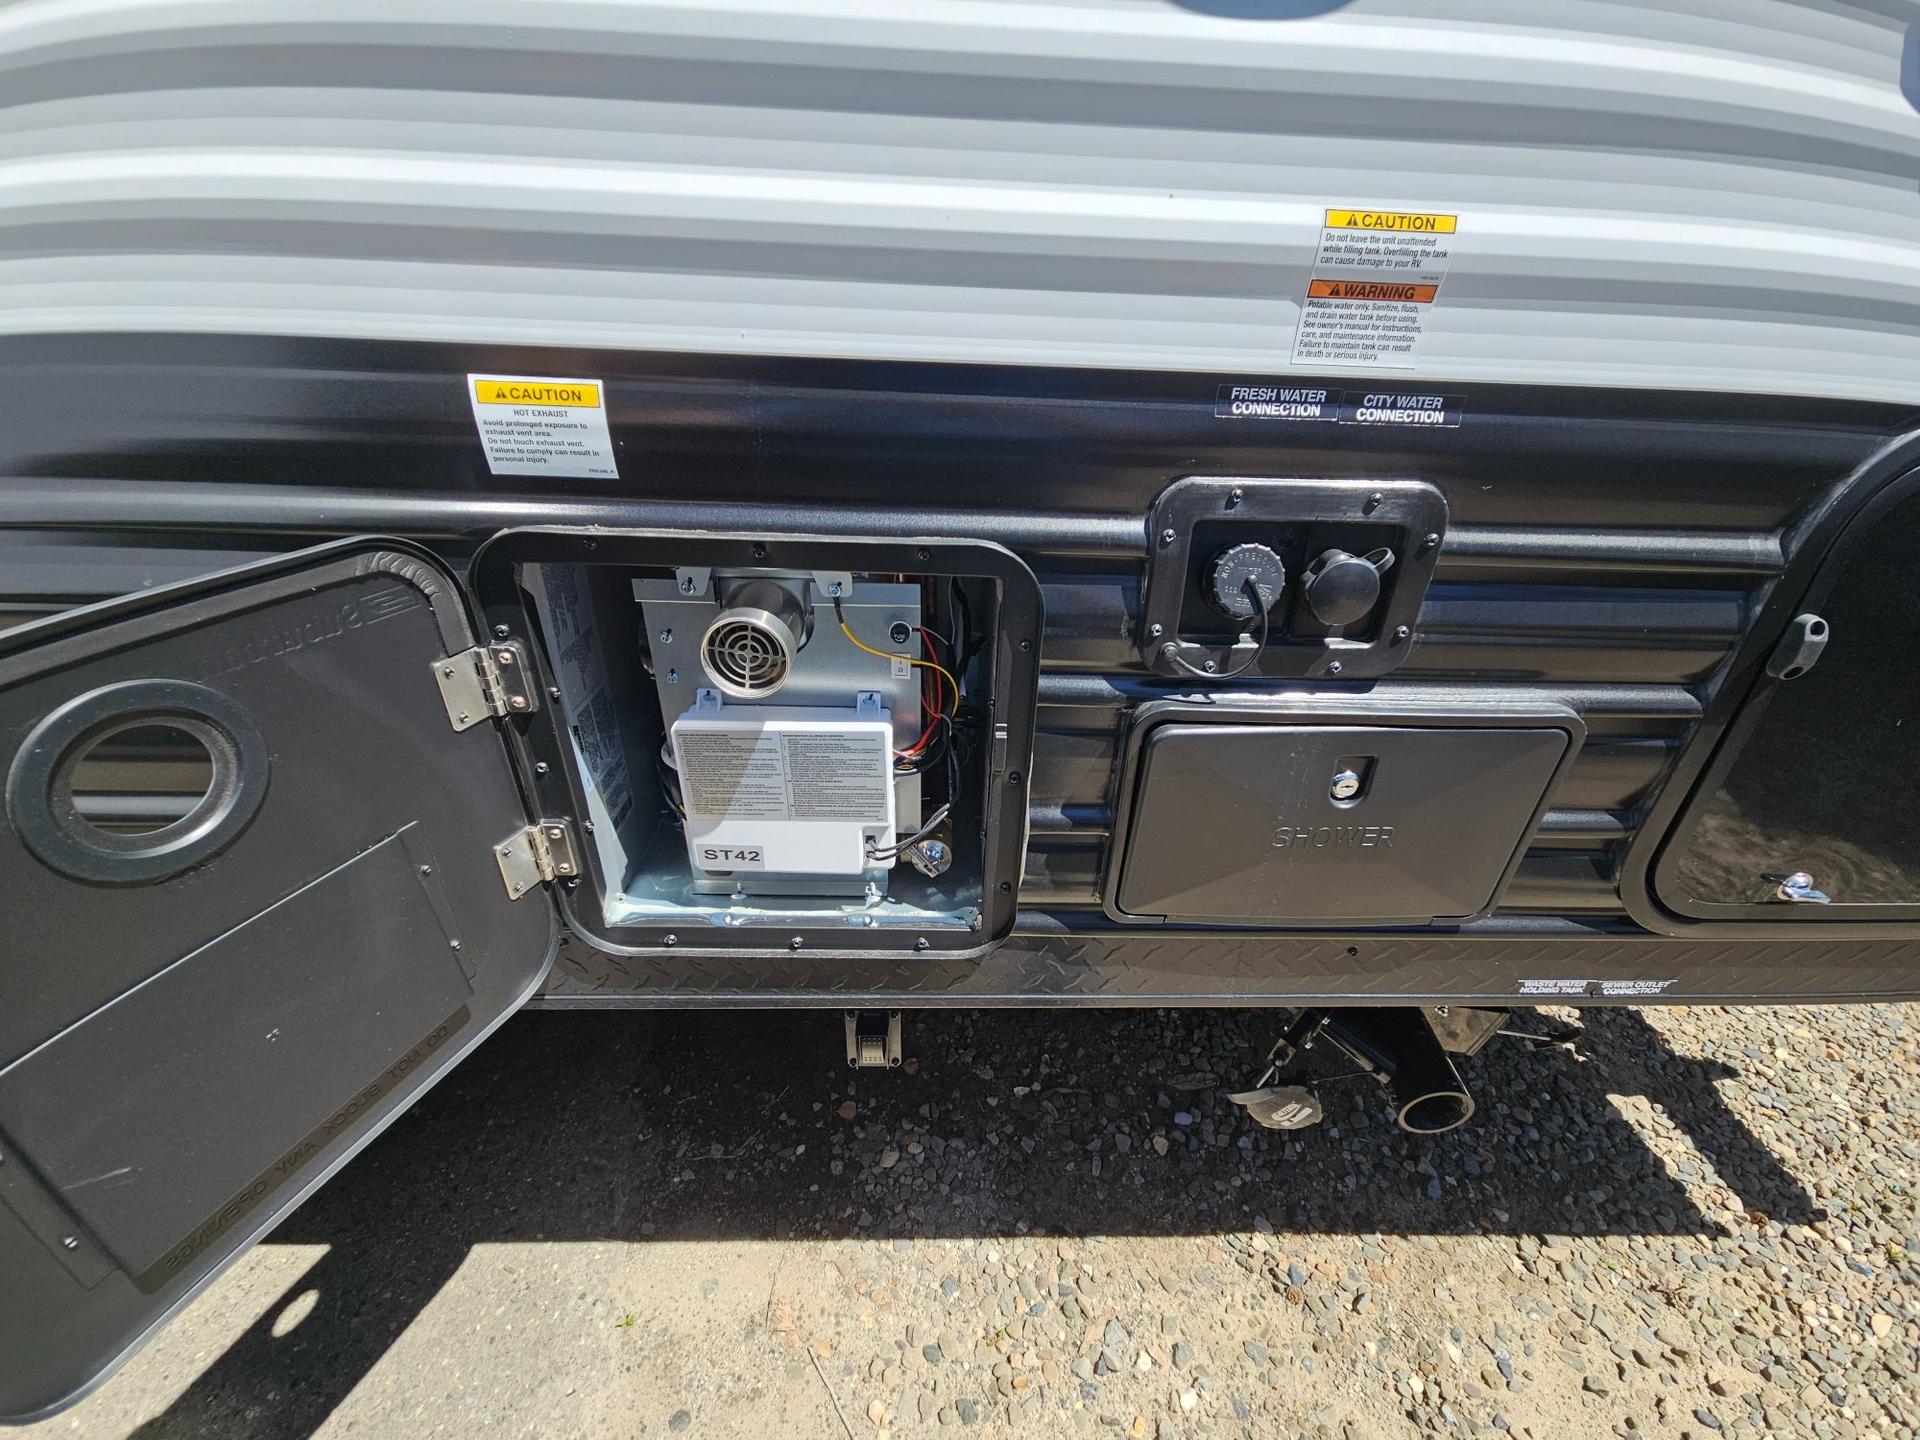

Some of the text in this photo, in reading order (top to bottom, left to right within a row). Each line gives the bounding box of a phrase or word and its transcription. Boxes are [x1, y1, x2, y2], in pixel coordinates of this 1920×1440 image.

[1362, 214, 1436, 230] CAUTION
[1326, 233, 1335, 241] Do
[1337, 234, 1348, 242] not
[1350, 234, 1368, 243] leave
[1382, 236, 1396, 244] unit
[1397, 237, 1436, 246] unattended
[1323, 245, 1342, 253] while
[1343, 246, 1363, 255] filling
[1384, 248, 1418, 258] Overfilling
[1357, 258, 1384, 268] damage
[1344, 286, 1416, 300] WARNING
[1308, 301, 1333, 309] Potable
[1355, 303, 1369, 311] only.
[1372, 303, 1400, 312] Sanitize,
[1401, 305, 1420, 313] flush,
[1398, 316, 1418, 324] using.
[1382, 324, 1422, 334] instructions,
[1358, 352, 1378, 361] injury.
[510, 388, 582, 401] CAUTION
[1231, 388, 1326, 402] FRESH WATER
[1364, 394, 1443, 408] CITY WATER
[1232, 402, 1321, 416] CONNECTION
[1356, 408, 1444, 423] CONNECTION
[505, 421, 543, 429] prolonged
[1272, 827, 1395, 848] SHOWER
[704, 850, 761, 862] ST42
